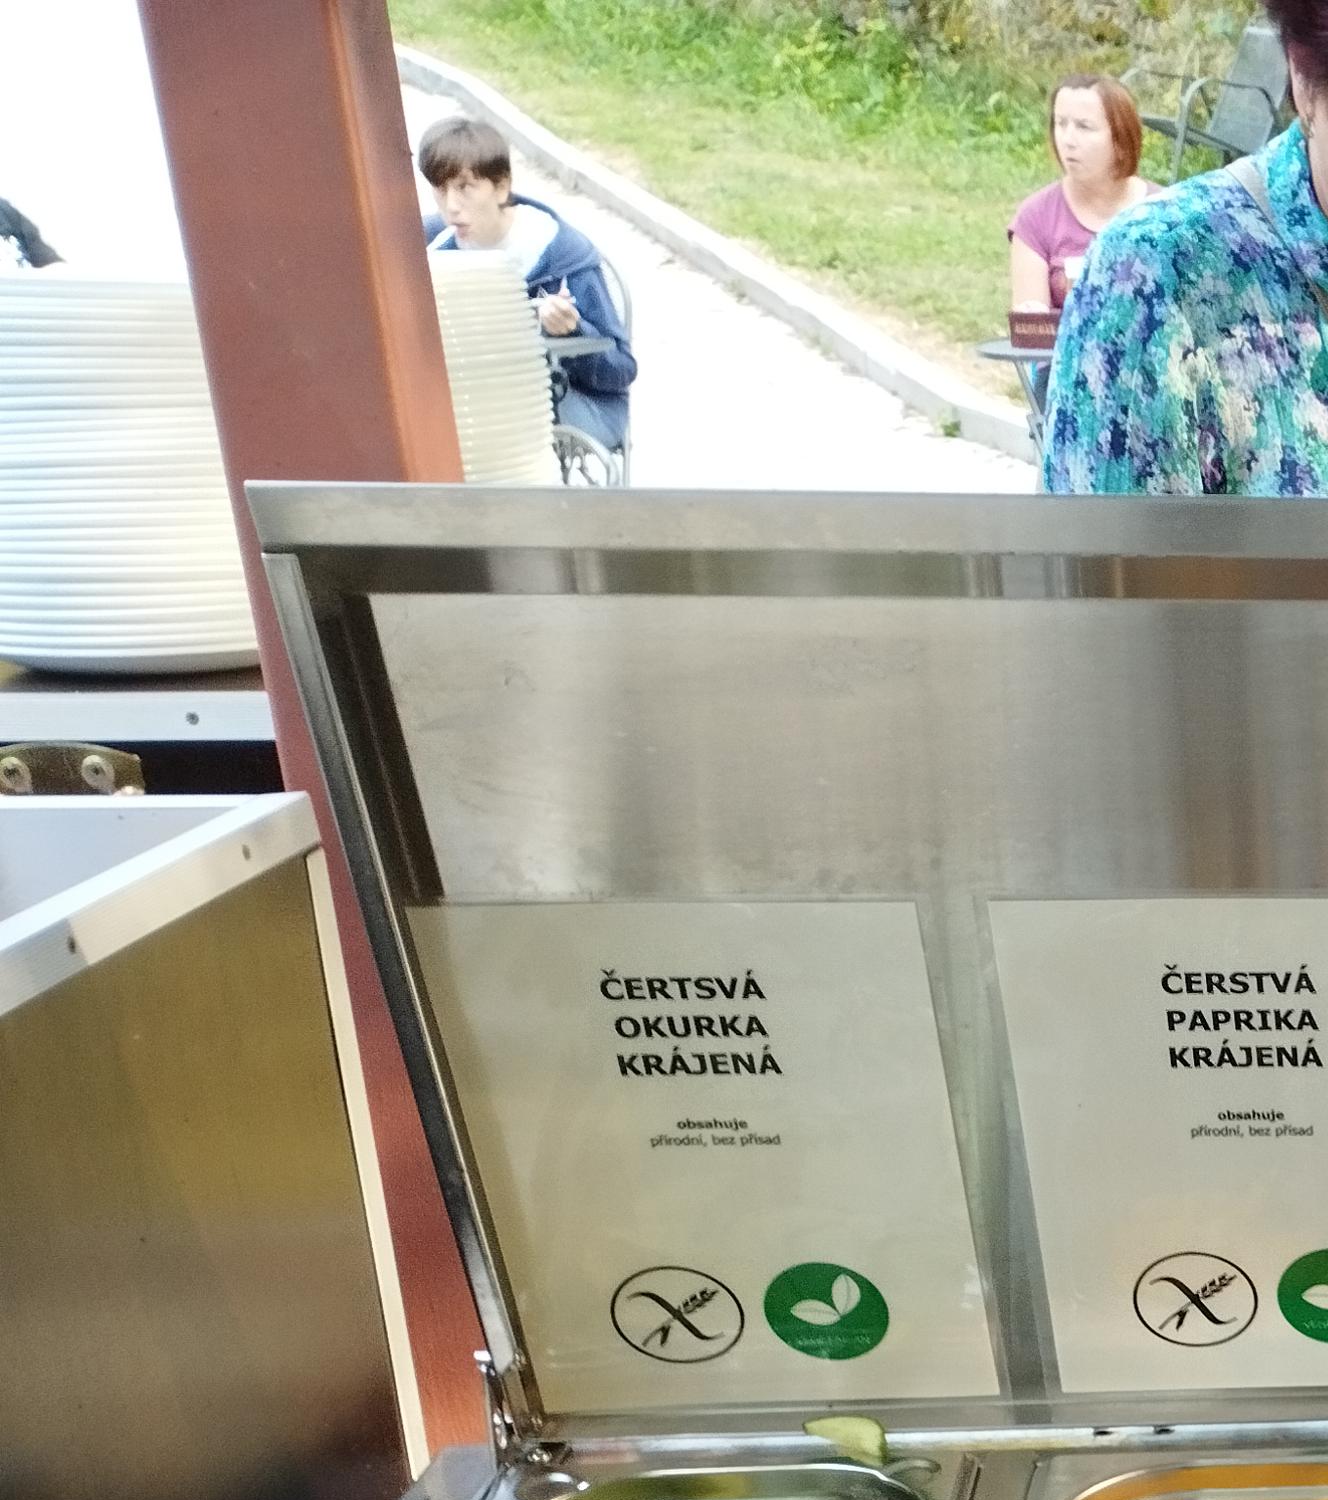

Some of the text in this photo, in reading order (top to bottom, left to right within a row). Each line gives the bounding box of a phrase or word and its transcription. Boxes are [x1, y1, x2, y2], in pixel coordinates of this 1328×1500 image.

[600, 968, 768, 1000] ČERTSVÁ
[1161, 963, 1317, 995] ČERSTVÁ
[614, 1014, 770, 1039] OKURKA
[1166, 1008, 1320, 1032] PAPRIKA
[617, 1045, 783, 1077] KRÁJENÁ
[1168, 1038, 1324, 1069] KRÁJENÁ
[676, 1118, 748, 1131] obsahuje
[1217, 1109, 1284, 1122] obsahuje
[711, 1133, 736, 1145] bez
[1248, 1125, 1271, 1136] bez
